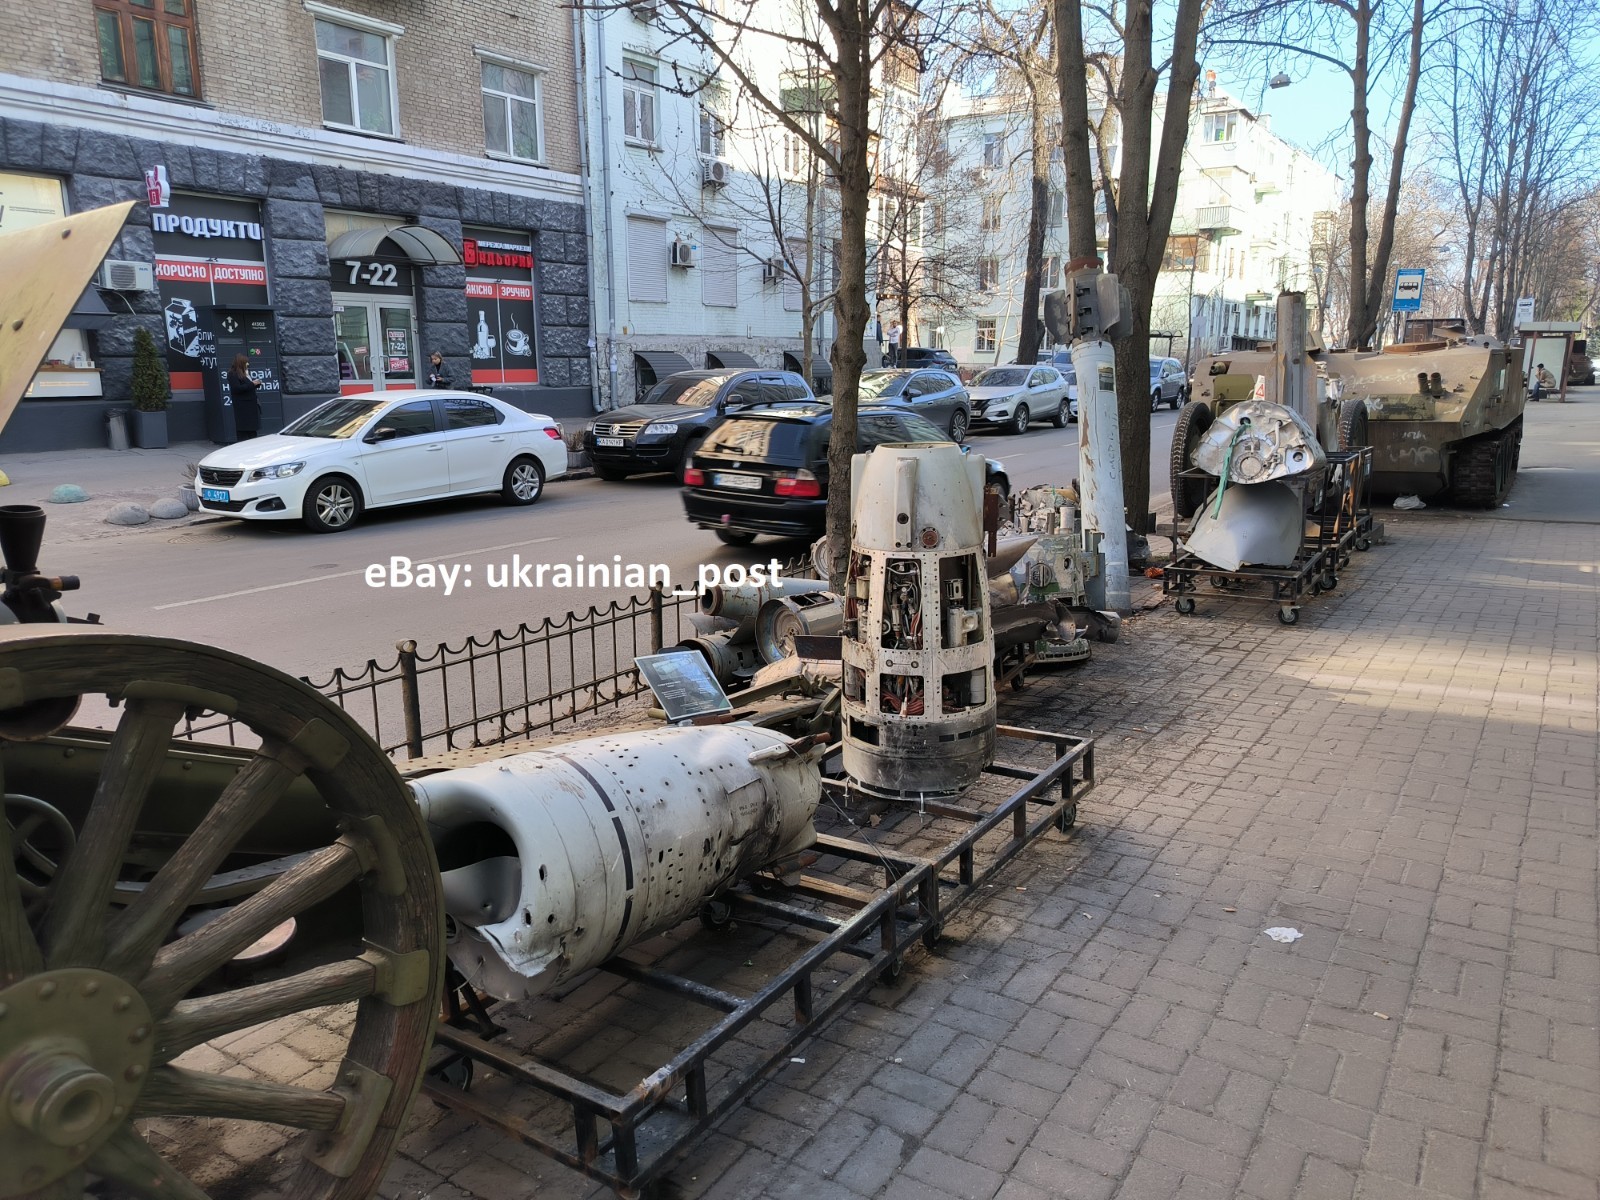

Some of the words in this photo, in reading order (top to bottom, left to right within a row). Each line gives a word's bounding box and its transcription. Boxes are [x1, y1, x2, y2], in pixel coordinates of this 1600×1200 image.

[153, 213, 261, 240] ПРОДУКТИ
[155, 264, 206, 279] КОРИСНО
[214, 267, 264, 281] ДОСТУПНО
[345, 260, 398, 287] 7-22
[466, 284, 493, 295] ЯКІСНО
[501, 286, 530, 298] ЗРУЧНО
